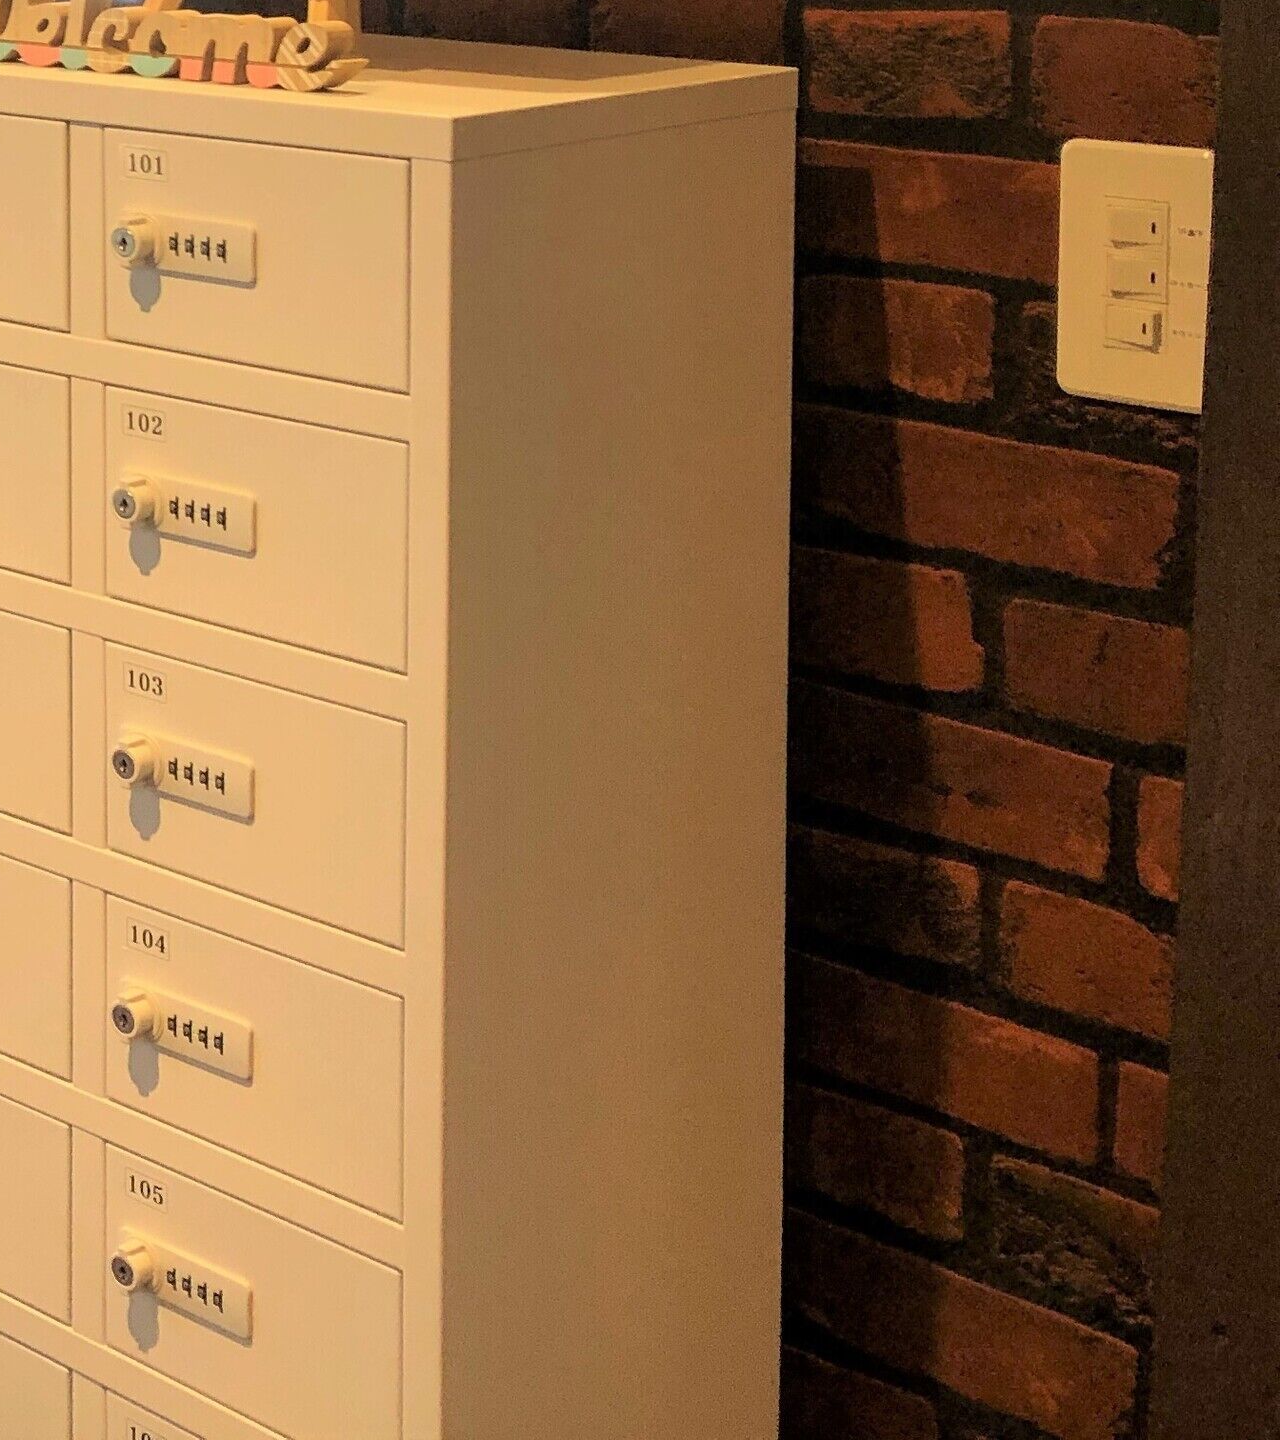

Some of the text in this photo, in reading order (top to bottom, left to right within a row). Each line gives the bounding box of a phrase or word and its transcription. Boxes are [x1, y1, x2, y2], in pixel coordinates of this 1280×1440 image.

[130, 153, 163, 176] 101
[128, 411, 163, 436] 102
[129, 669, 163, 696] 103
[132, 925, 165, 954] 104
[130, 1175, 164, 1205] 105
